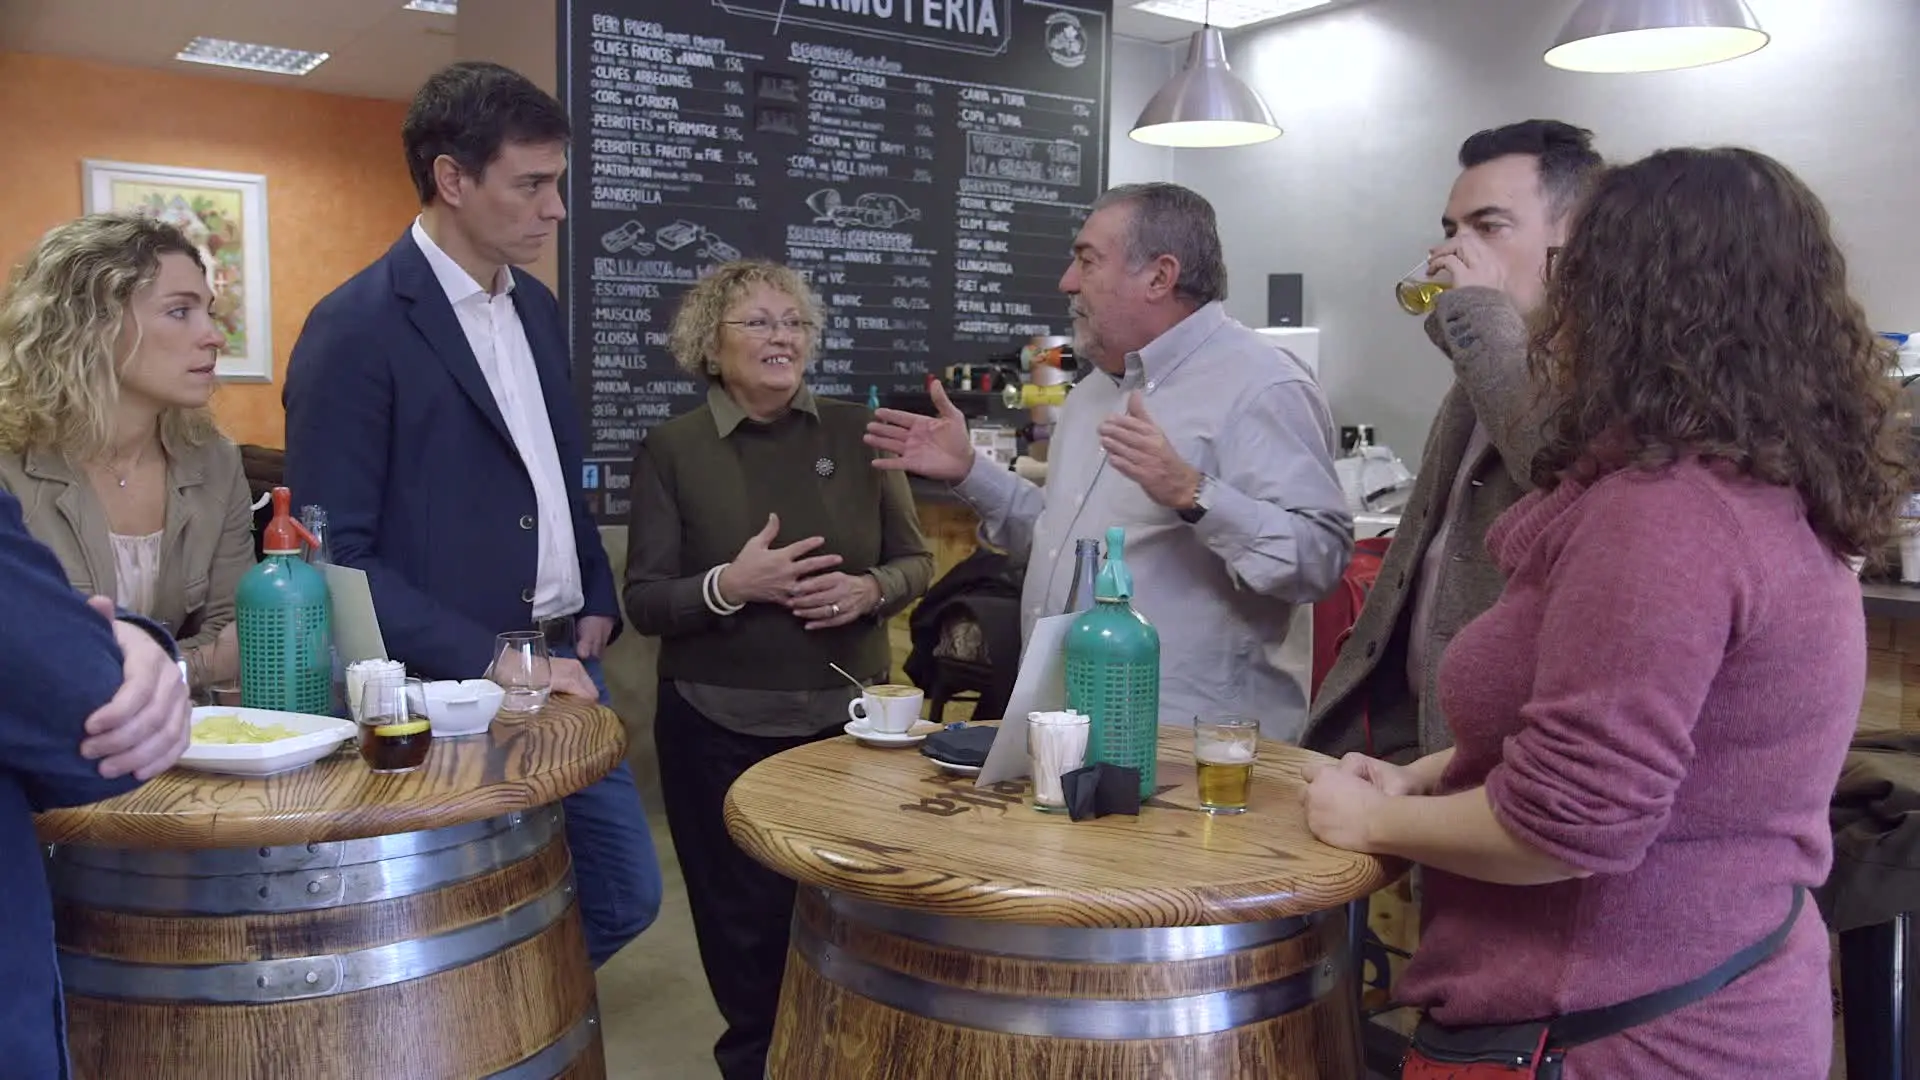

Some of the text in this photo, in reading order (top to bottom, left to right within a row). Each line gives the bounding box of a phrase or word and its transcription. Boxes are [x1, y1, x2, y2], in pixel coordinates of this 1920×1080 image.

[595, 66, 631, 82] OLIVES
[594, 187, 663, 205] BANDERILLA
[595, 308, 652, 323] MUSCLOS
